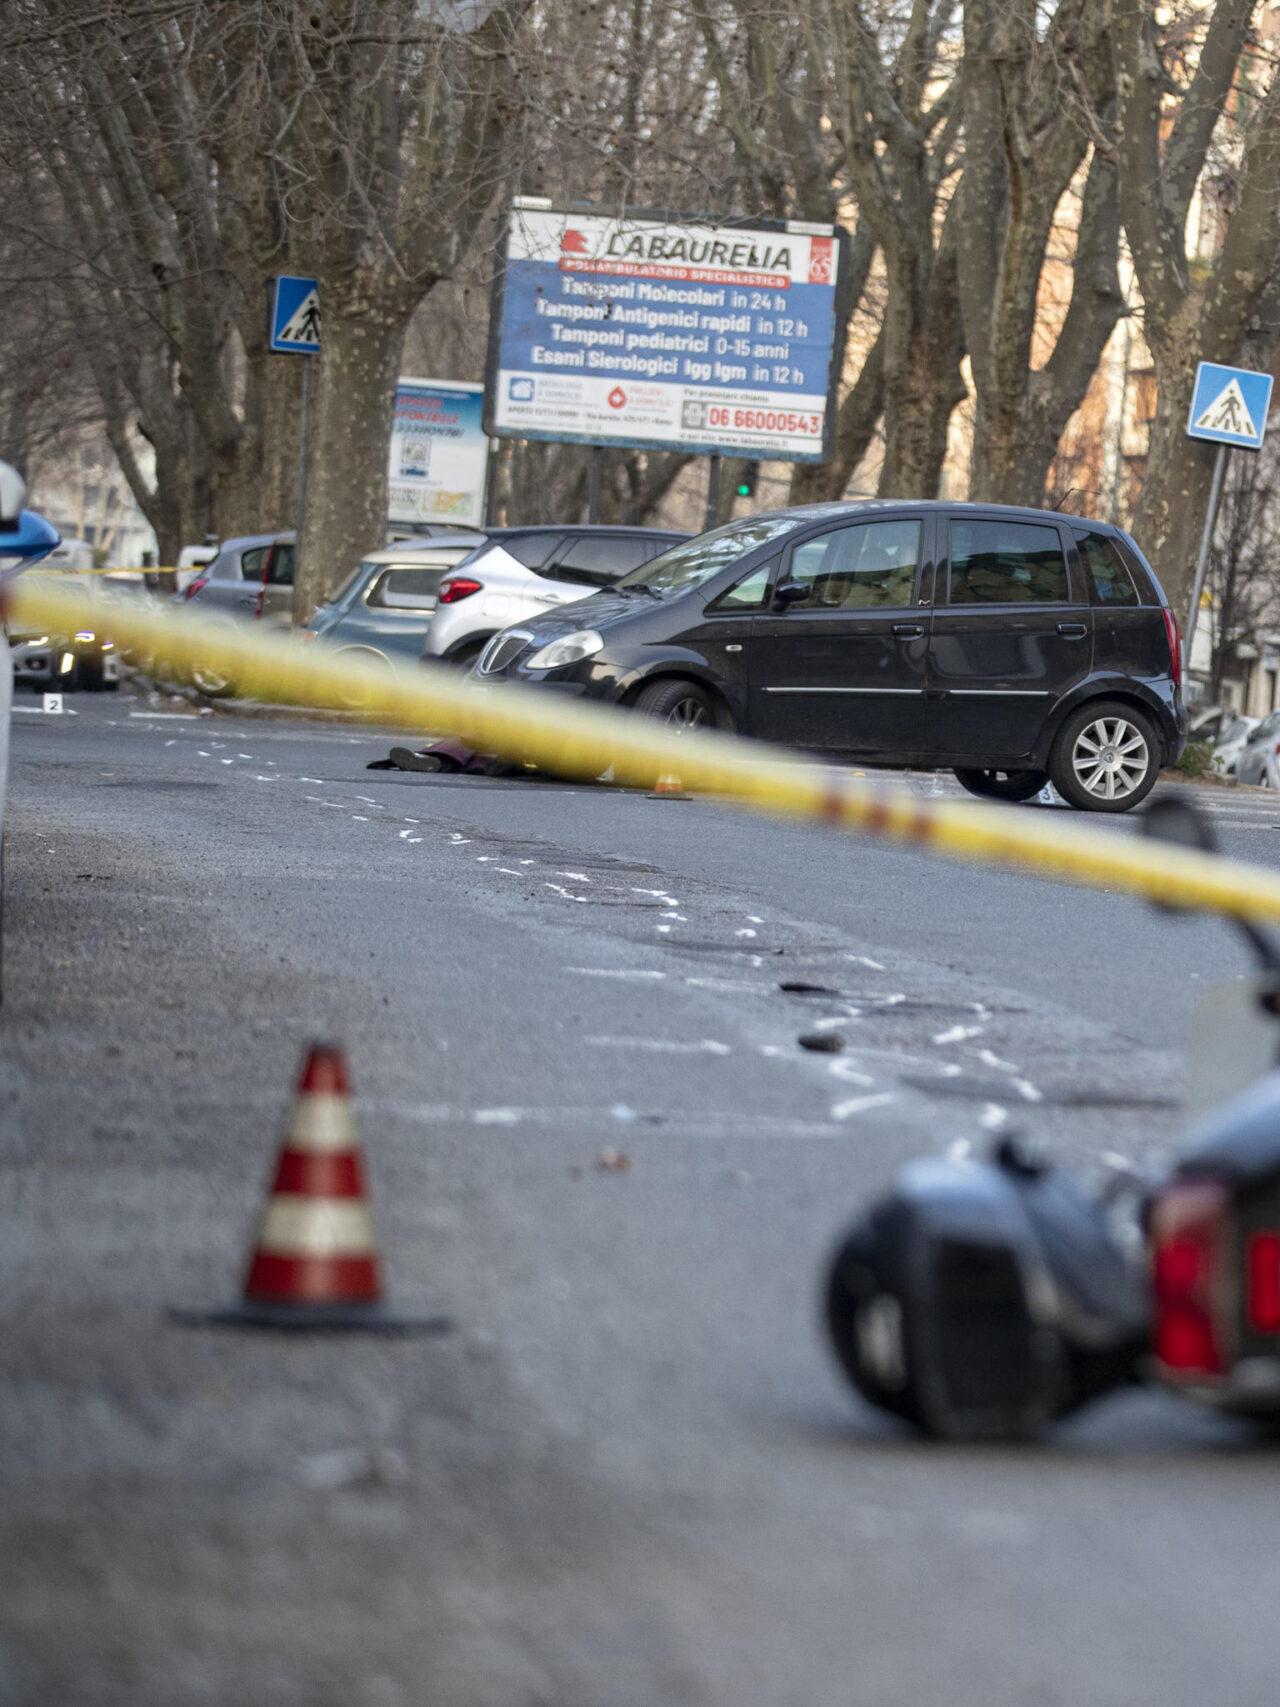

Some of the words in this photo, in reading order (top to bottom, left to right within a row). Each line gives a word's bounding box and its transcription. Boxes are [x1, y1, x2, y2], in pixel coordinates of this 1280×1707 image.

[607, 233, 792, 271] LABAURELIA
[562, 276, 635, 299] Tamponi
[638, 283, 726, 307] Molecolari
[731, 290, 748, 308] in
[751, 291, 772, 311] 24
[775, 294, 787, 312] h
[691, 269, 786, 287] SPECIALISTICO
[612, 304, 699, 328] Antigenici
[702, 313, 751, 334] rapidi
[757, 316, 774, 335] in
[777, 318, 794, 337] 12
[796, 319, 808, 338] h
[551, 322, 625, 347] Tamponi
[626, 331, 709, 353] pediatrici
[715, 336, 750, 357] 0-15
[753, 342, 789, 360] anni
[531, 345, 585, 367] Esami
[587, 350, 678, 377] Sierologici
[753, 364, 770, 383] in
[773, 365, 790, 384] 12
[792, 367, 804, 386] h
[709, 407, 730, 426] 06
[734, 409, 821, 435] 66000543
[50, 700, 59, 711] 2
[1042, 786, 1050, 801] 3
